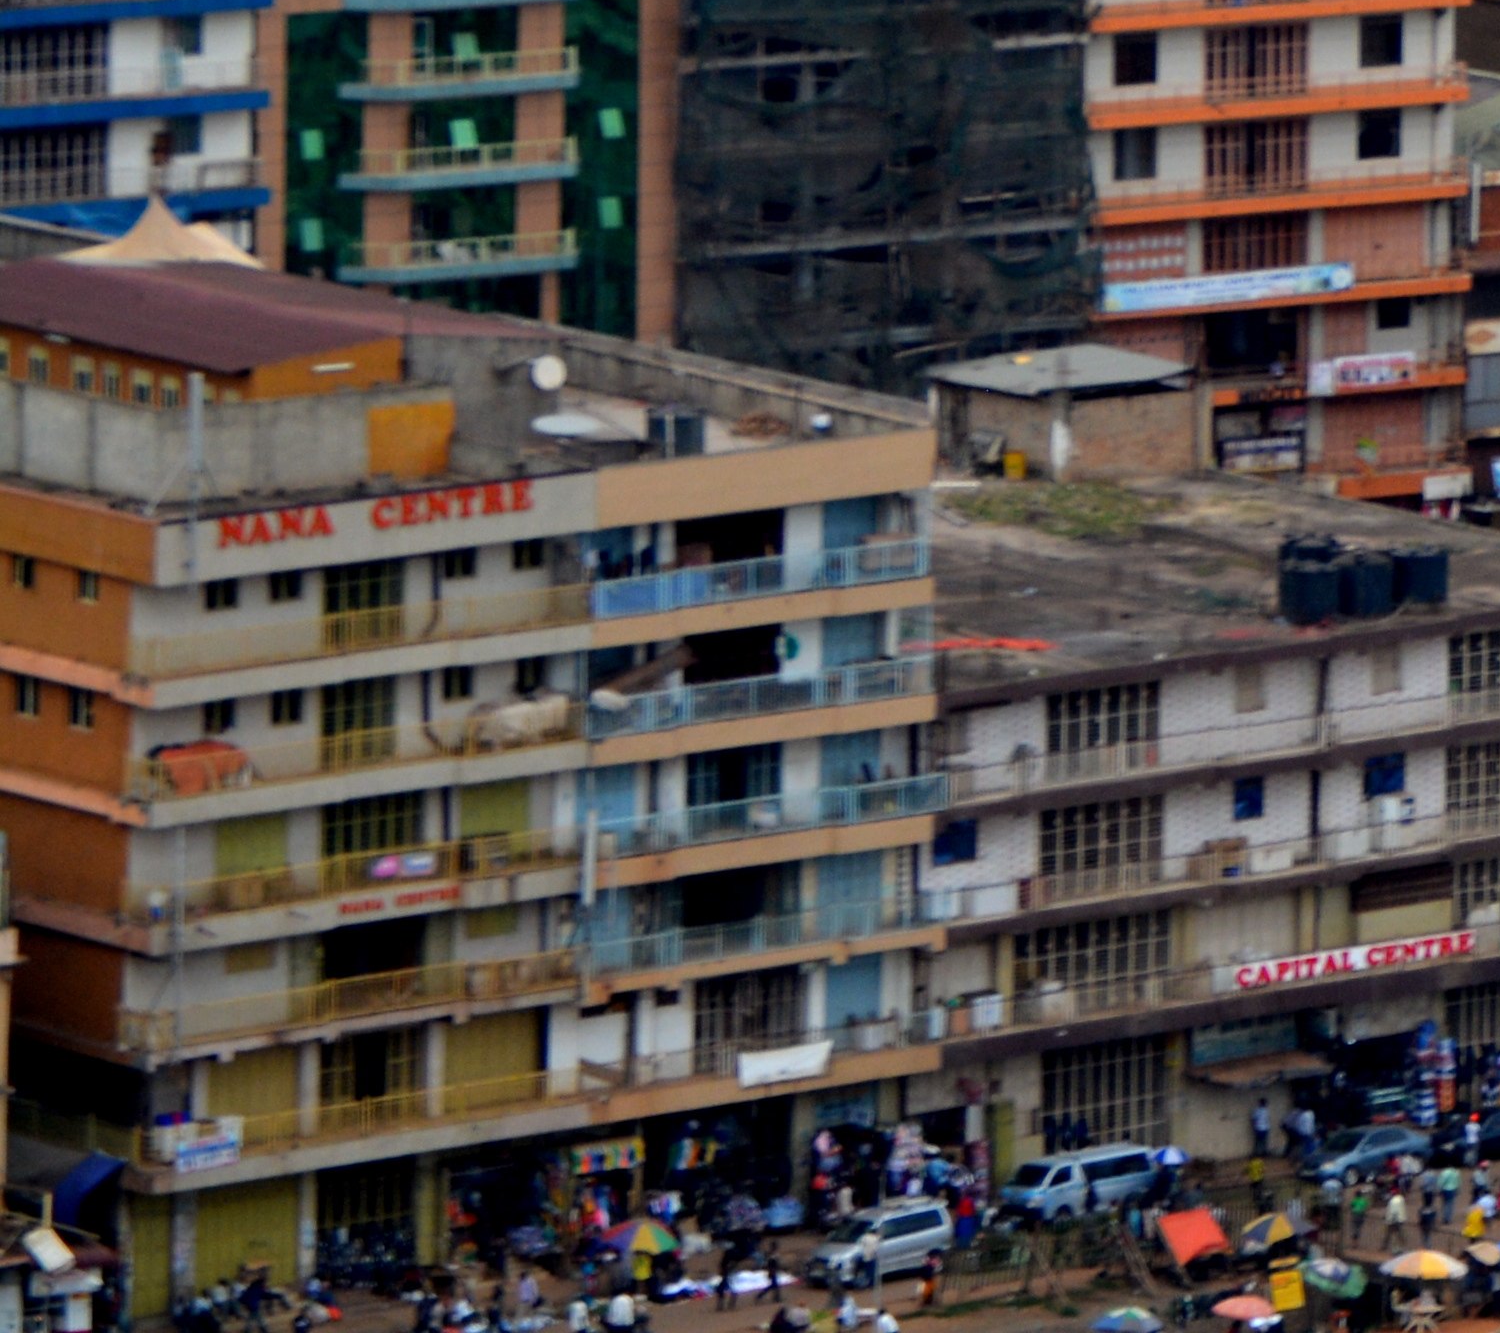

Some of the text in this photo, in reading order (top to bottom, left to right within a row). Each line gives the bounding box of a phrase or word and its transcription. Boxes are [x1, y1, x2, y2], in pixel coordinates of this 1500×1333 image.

[217, 479, 533, 549] NANA CENTRE
[1236, 933, 1476, 988] CAPITAL CENTRE
